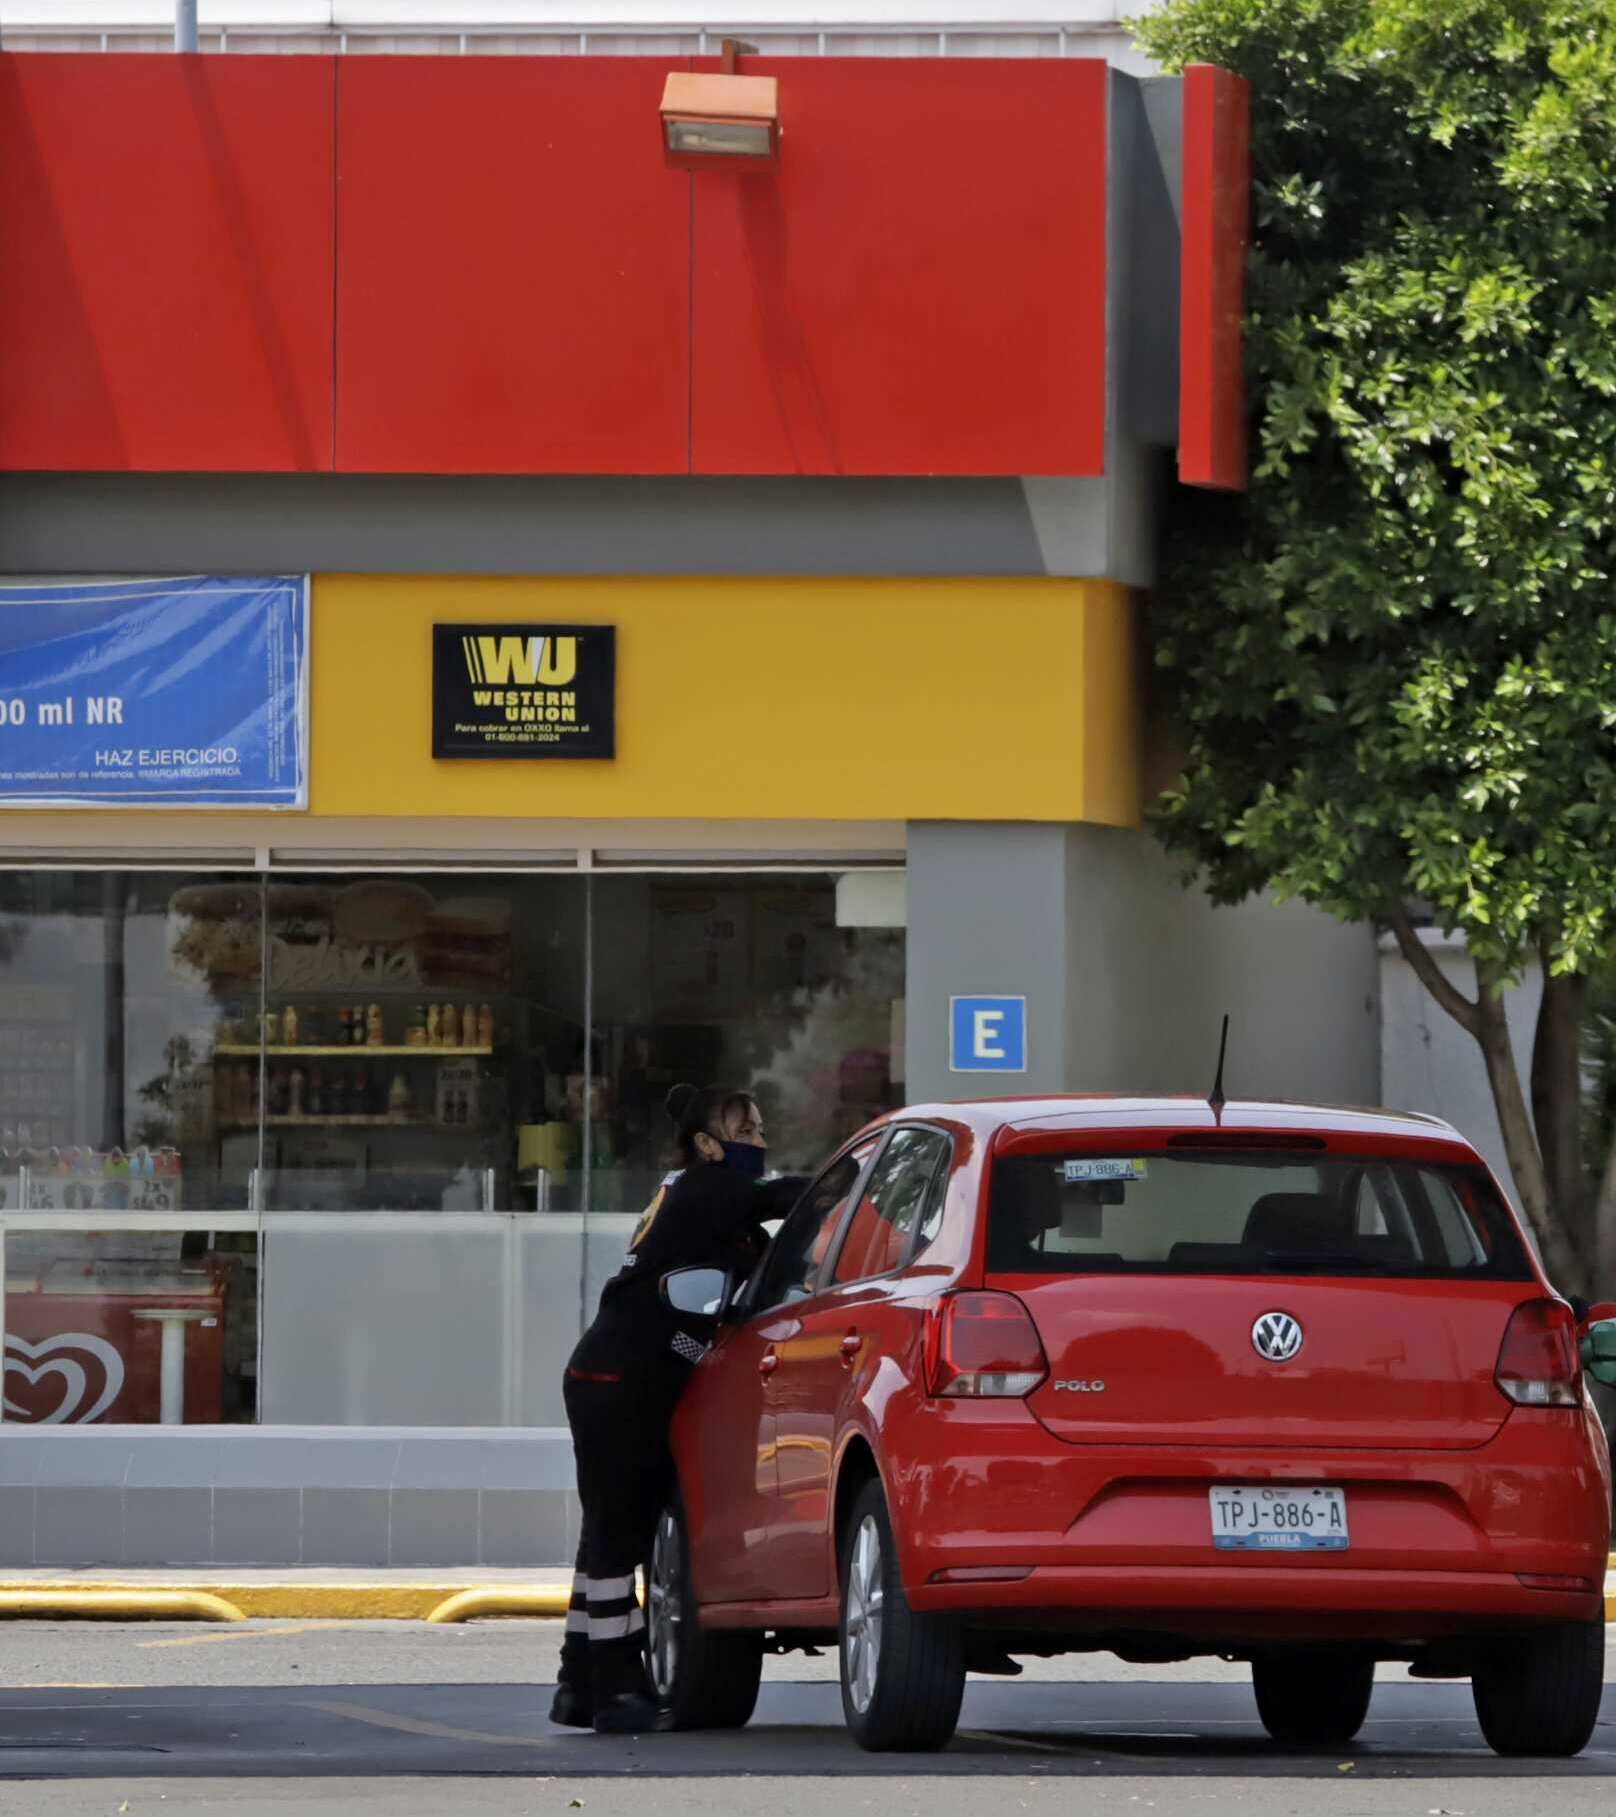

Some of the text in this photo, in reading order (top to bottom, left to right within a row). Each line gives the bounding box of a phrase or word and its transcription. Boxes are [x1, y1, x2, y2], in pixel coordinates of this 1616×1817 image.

[463, 636, 577, 686] WU
[473, 691, 576, 706] WESTERN
[38, 696, 73, 725] ml
[87, 696, 123, 724] NR
[505, 707, 576, 721] UNION
[96, 747, 241, 767] HAZ EJERCICIO.
[974, 1010, 1006, 1058] E
[1054, 1380, 1105, 1392] POLO
[1217, 1501, 1341, 1528] TPJ-886-A
